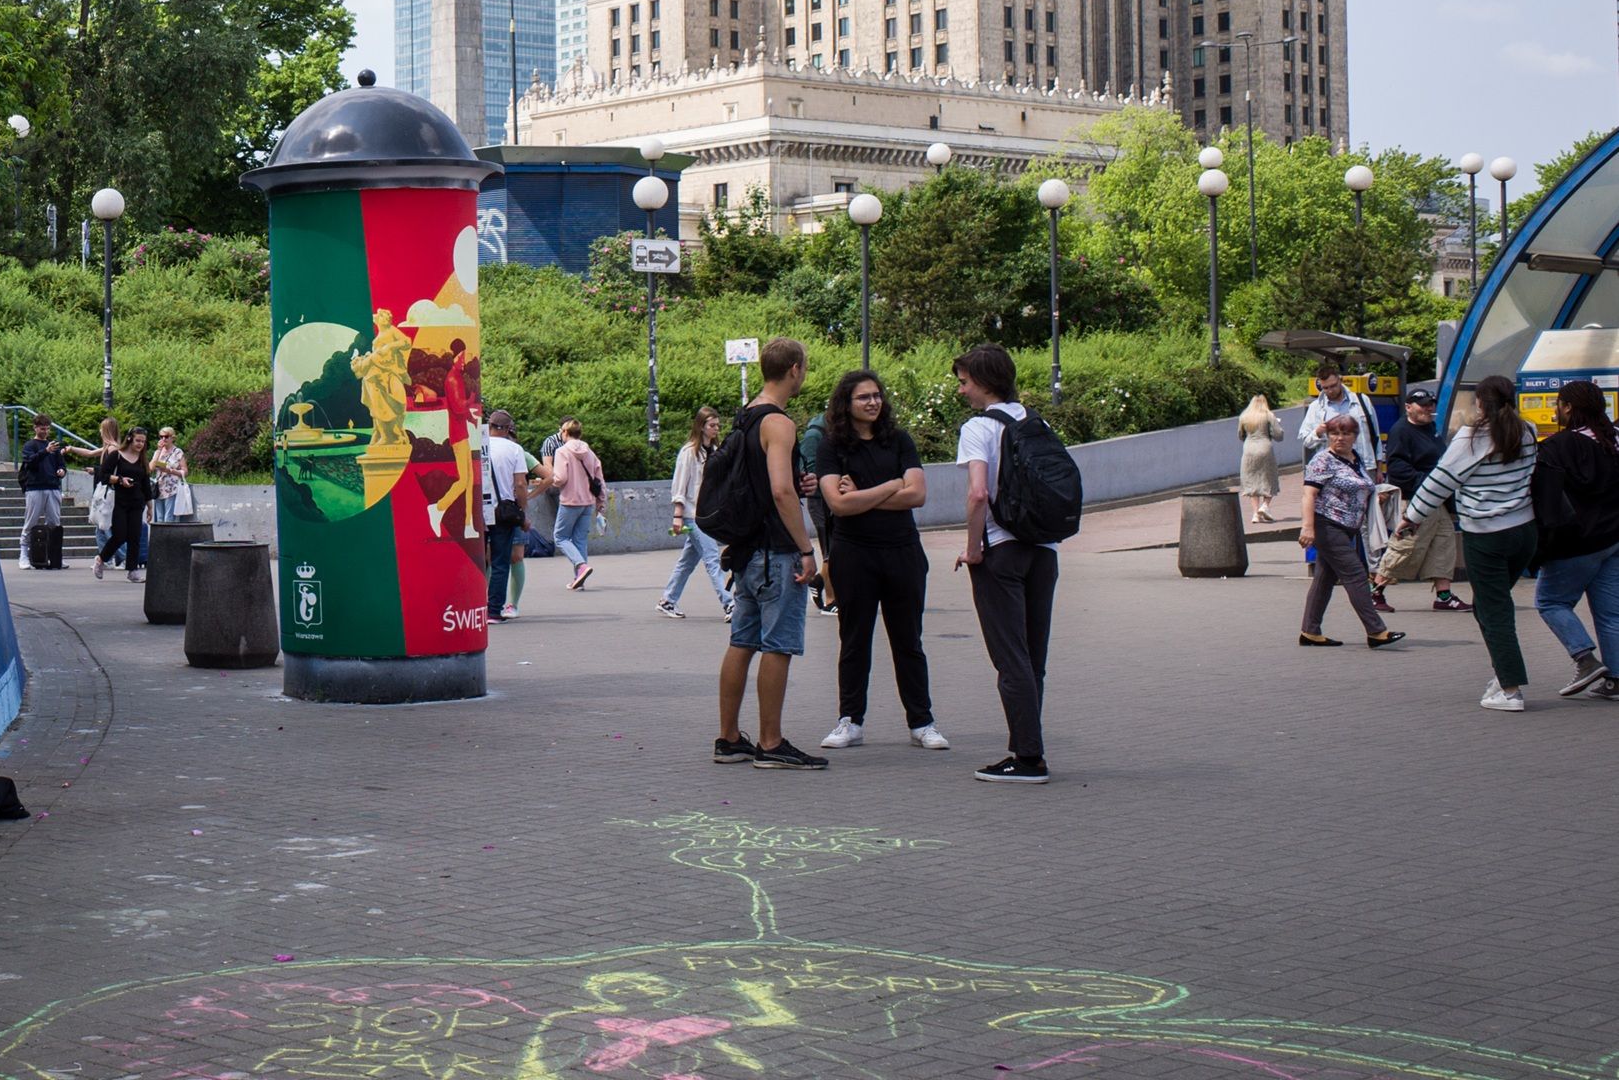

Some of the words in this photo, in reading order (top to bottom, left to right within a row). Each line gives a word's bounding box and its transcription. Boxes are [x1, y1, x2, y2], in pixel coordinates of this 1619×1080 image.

[1525, 380, 1547, 388] BILETY
[295, 631, 324, 640] Warszawa
[784, 974, 1139, 1000] BORDERS
[266, 1001, 511, 1038] STOP
